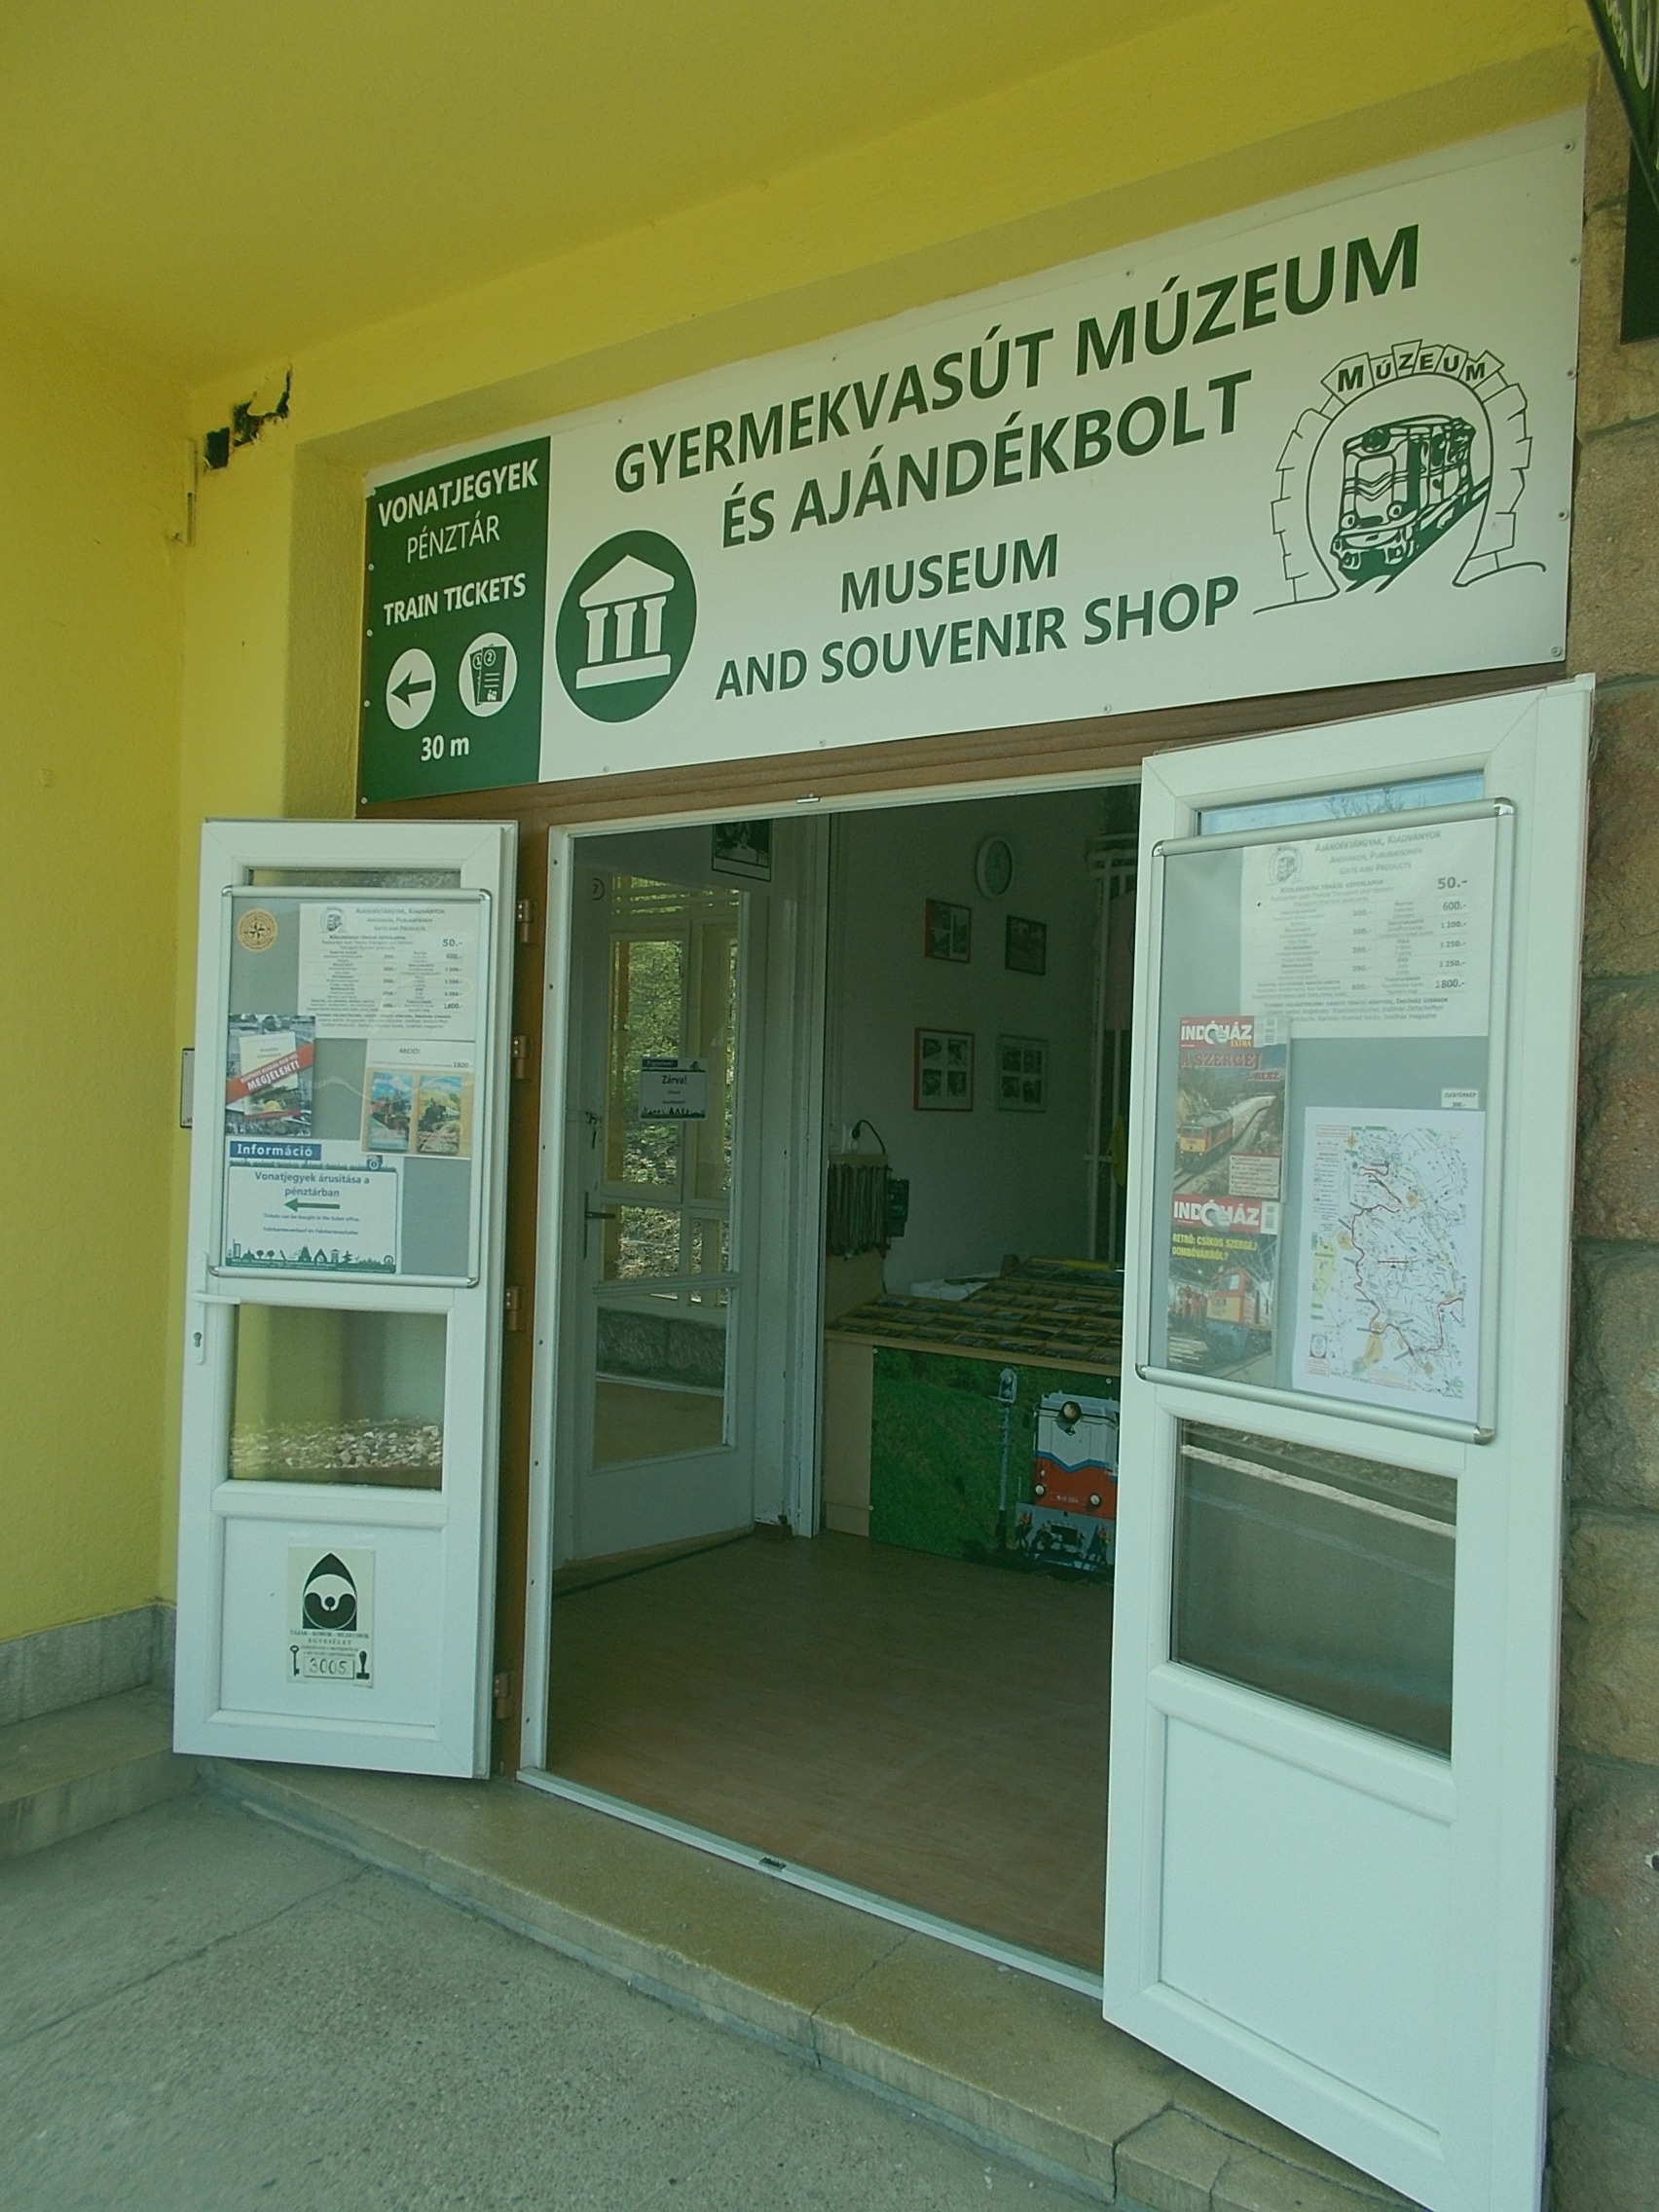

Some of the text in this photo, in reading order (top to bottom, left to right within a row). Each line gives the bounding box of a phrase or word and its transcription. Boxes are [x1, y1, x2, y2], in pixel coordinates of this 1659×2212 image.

[614, 224, 1419, 494] GYERMEKVASÚT MÚZEUM
[1337, 349, 1488, 392] MÚZEUM
[722, 370, 1252, 548] ÉS AJÁNDÉKBOLT
[378, 459, 539, 527] VONATJEGYEK
[406, 513, 500, 564] PÉNZTÁR
[840, 534, 1058, 613] MUSEUM
[383, 572, 527, 626] TRAIN TICKETS
[715, 574, 1240, 700] AND SOUVENIR SHOP
[421, 735, 470, 761] 30 m
[1180, 1020, 1253, 1045] INDÓHÁZ
[246, 1059, 300, 1091] MEGJELENT!
[661, 1075, 687, 1085] Zárva!
[237, 1143, 313, 1157] Információ
[255, 1170, 316, 1184] Vonatjegyek
[318, 1173, 361, 1184] árusítása
[284, 1187, 340, 1197] pénztárban
[1173, 1199, 1260, 1227] INDÓHÁZ
